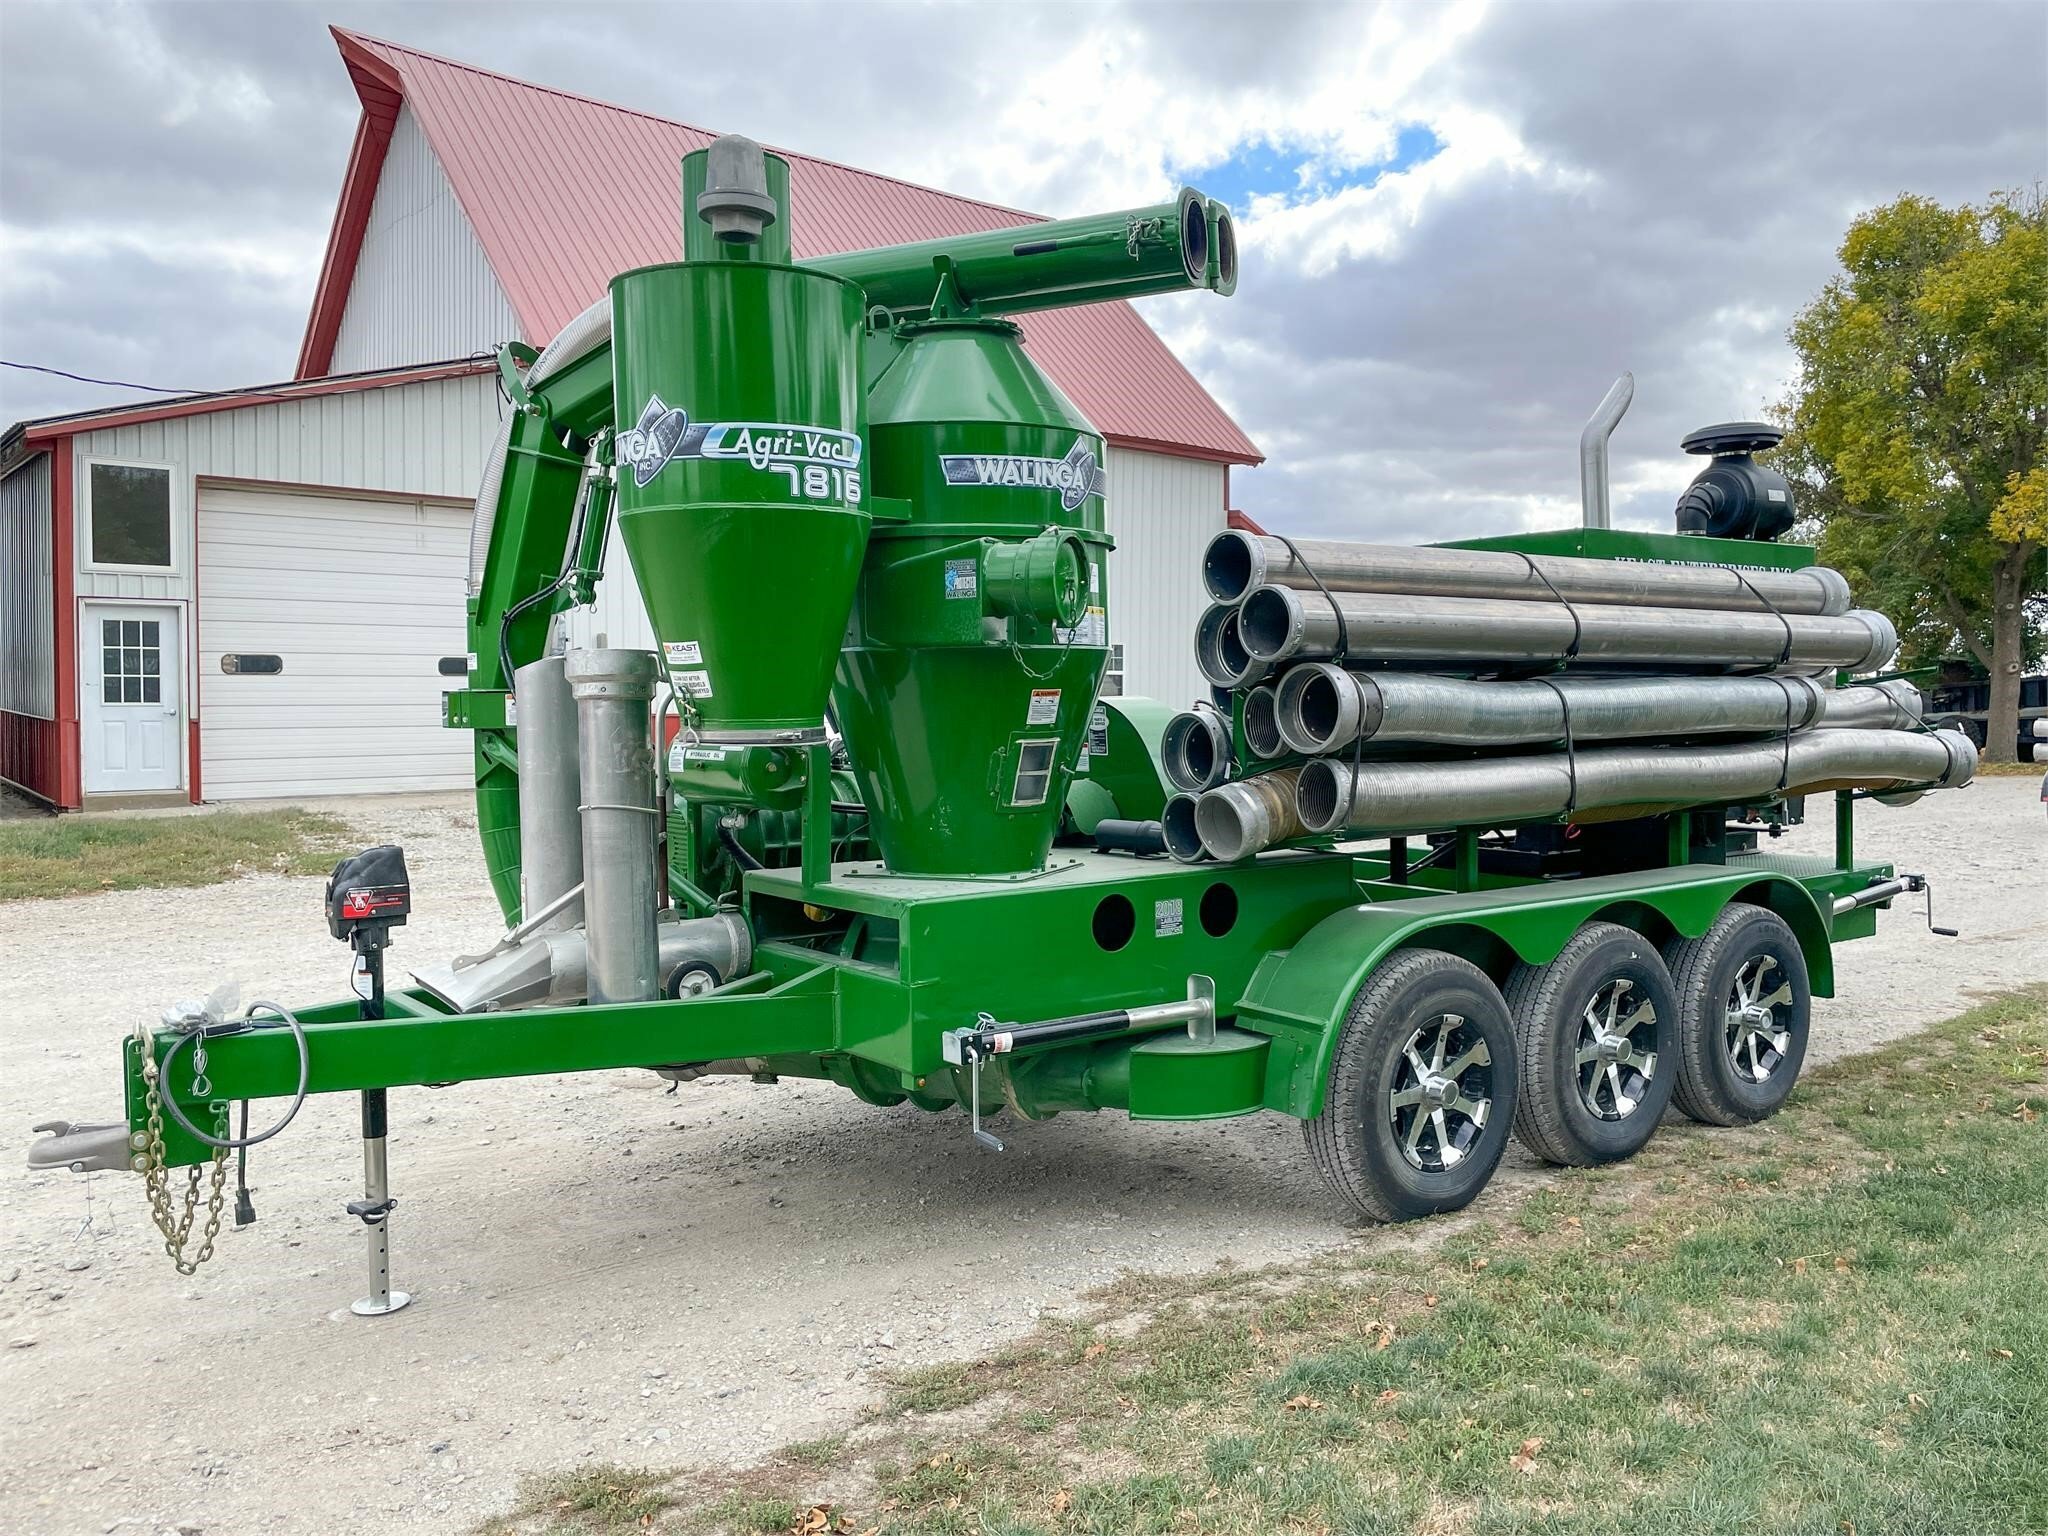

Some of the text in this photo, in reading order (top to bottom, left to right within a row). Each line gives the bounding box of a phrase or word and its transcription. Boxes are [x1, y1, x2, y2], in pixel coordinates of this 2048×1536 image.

[616, 431, 663, 464] INGA
[734, 428, 842, 469] Agri-Vac
[769, 463, 861, 503] 7816
[975, 459, 1085, 490] WALINGA
[672, 643, 697, 652] KEAST
